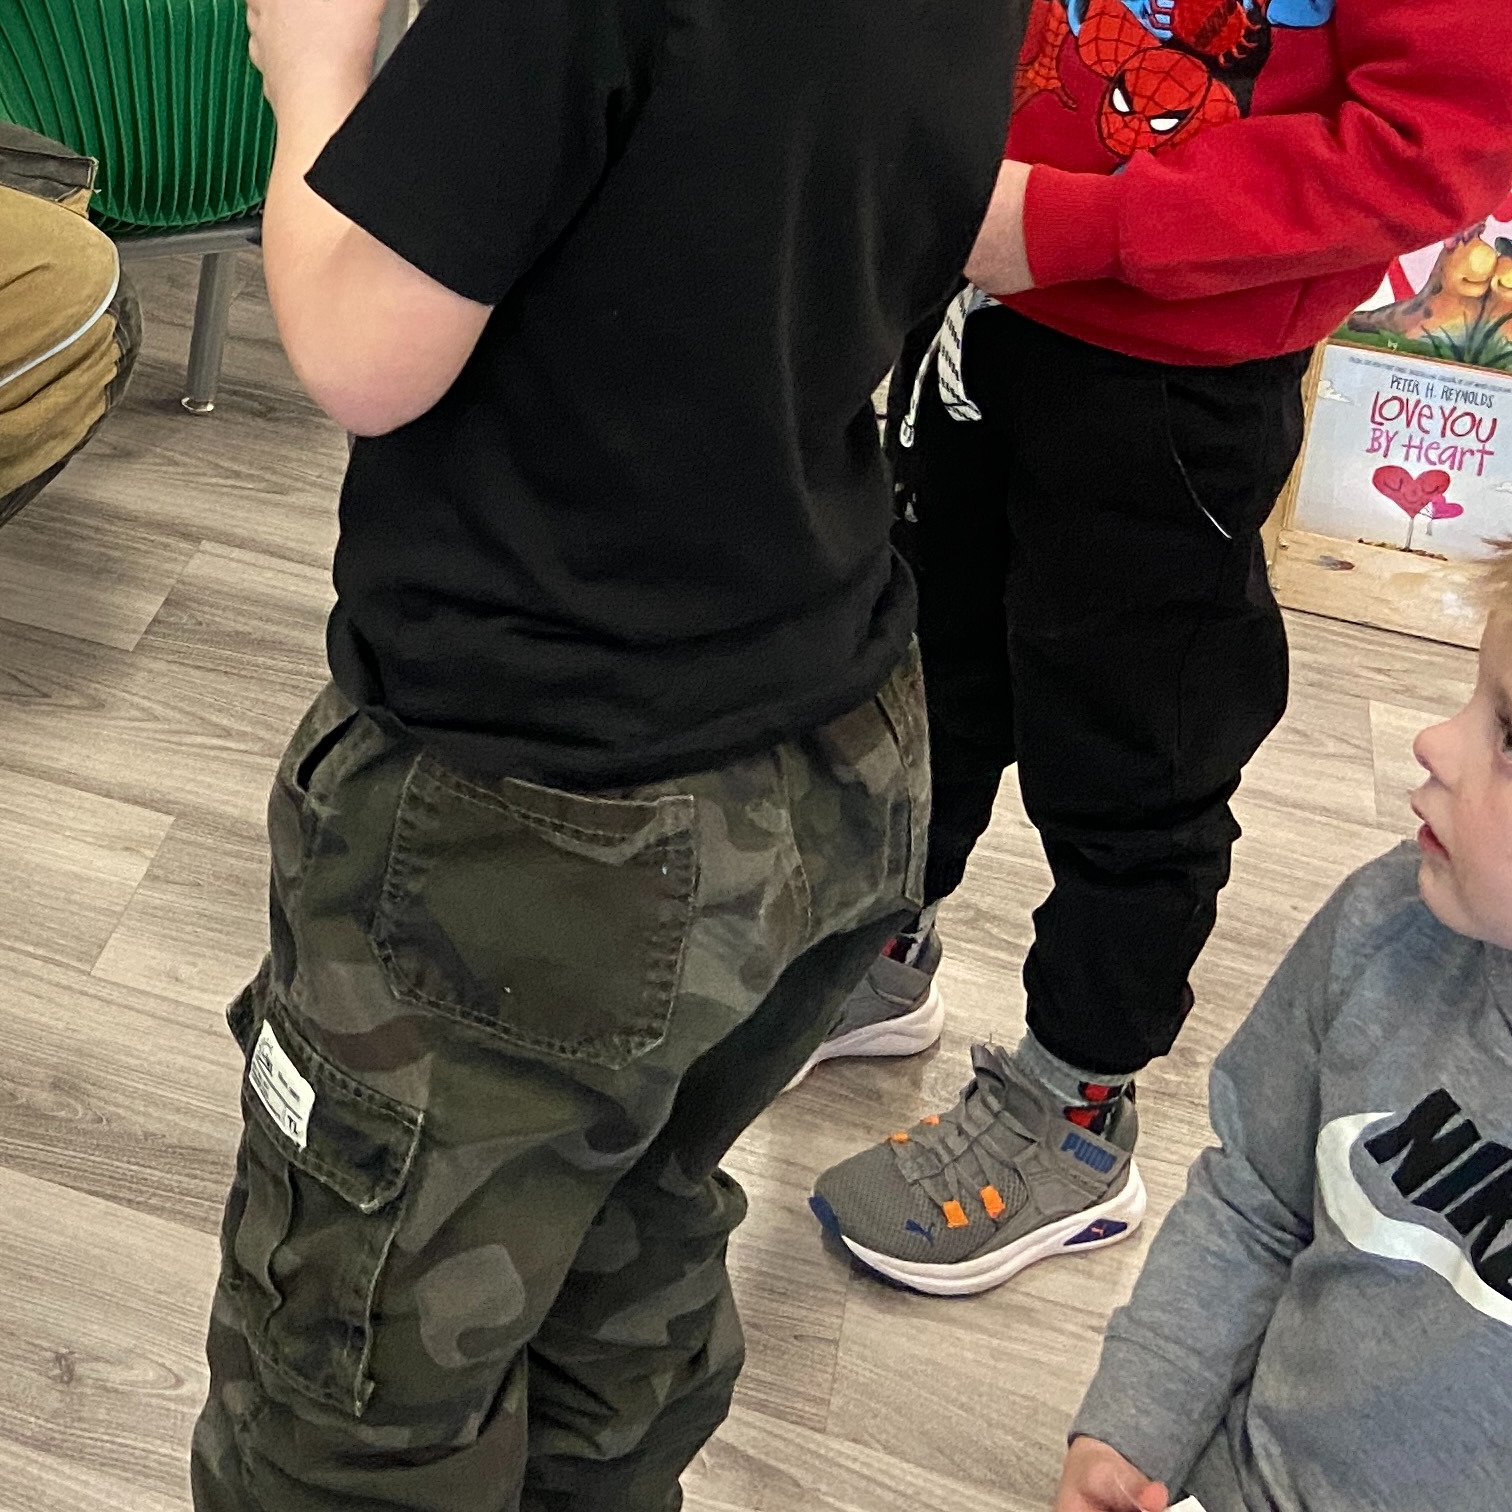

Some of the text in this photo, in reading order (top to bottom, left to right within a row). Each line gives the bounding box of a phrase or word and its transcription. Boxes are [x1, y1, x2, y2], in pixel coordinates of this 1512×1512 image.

[1390, 374, 1420, 396] PETER
[1441, 385, 1495, 409] REYNOLDS
[1439, 405, 1497, 444] YOU
[1365, 427, 1399, 458] BY
